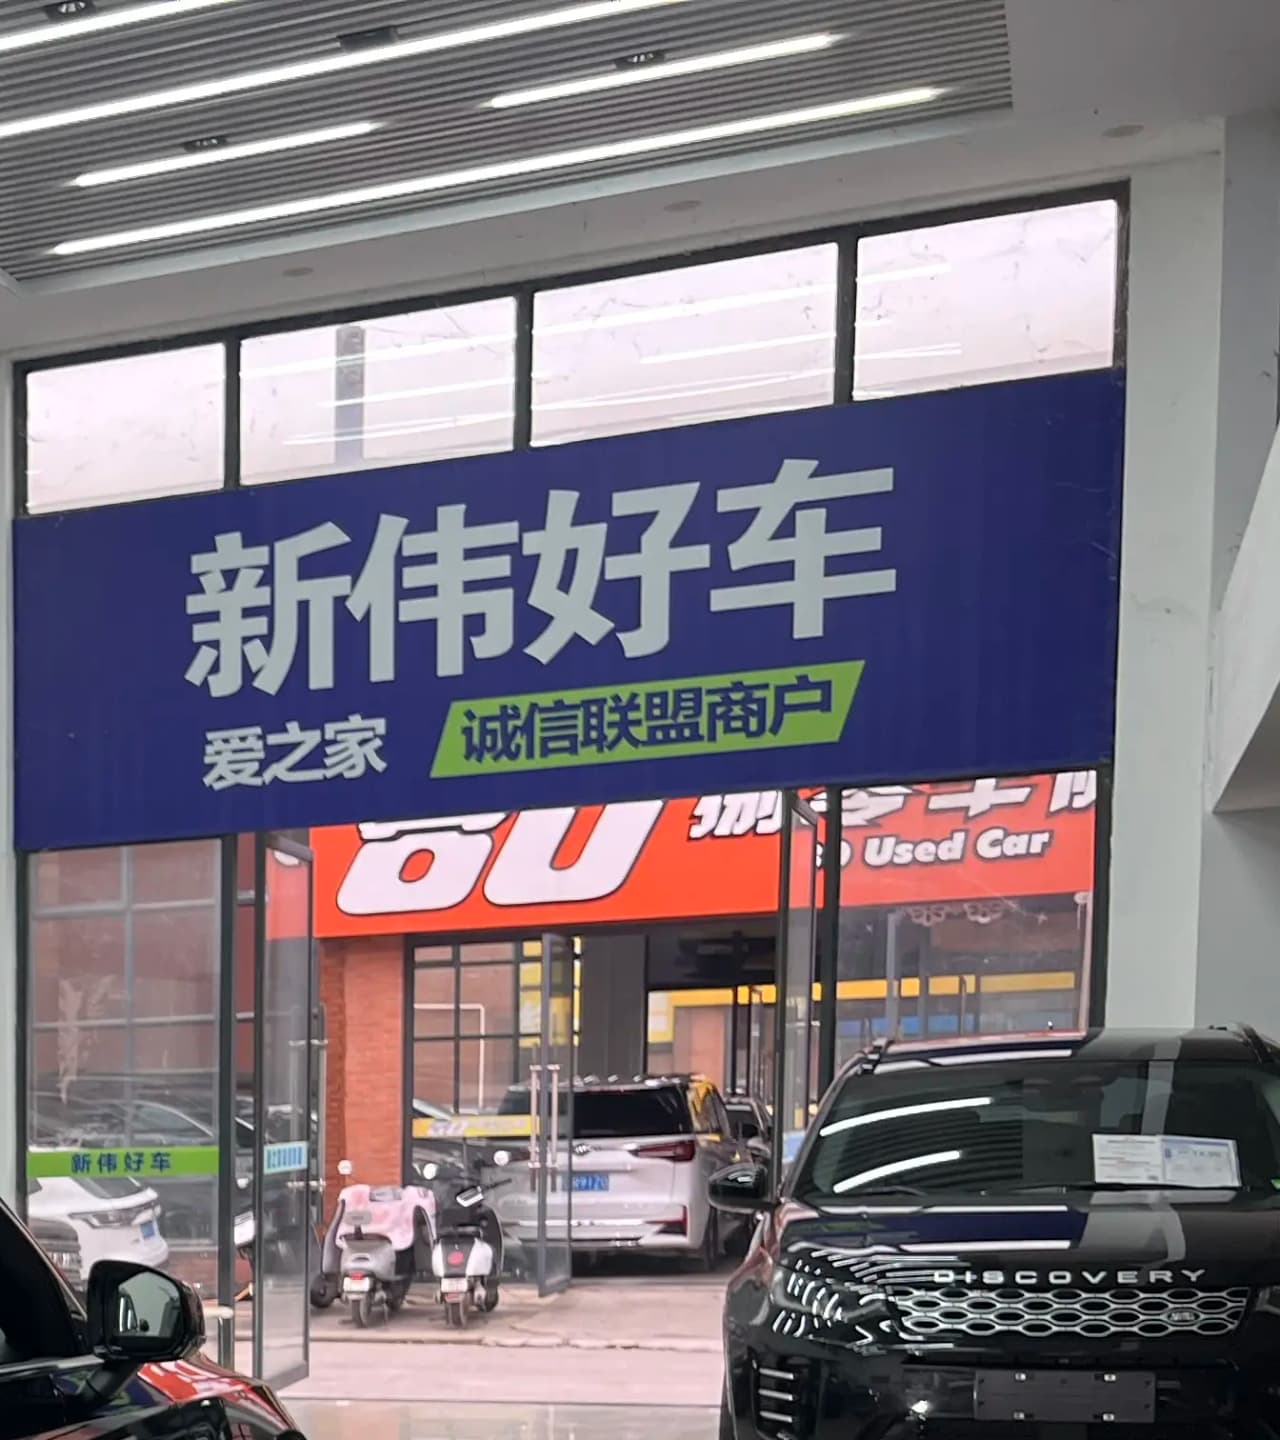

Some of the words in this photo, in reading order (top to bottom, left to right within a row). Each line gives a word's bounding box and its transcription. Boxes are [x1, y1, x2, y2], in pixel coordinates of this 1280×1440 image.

[183, 457, 898, 698] 新伟好车
[460, 672, 834, 763] 诚信联盟商户
[201, 713, 388, 790] 爱之家
[864, 830, 966, 867] Used
[975, 828, 1050, 858] Car
[71, 1151, 171, 1174] 新伟好车
[933, 1268, 1206, 1285] DISCOVERY
